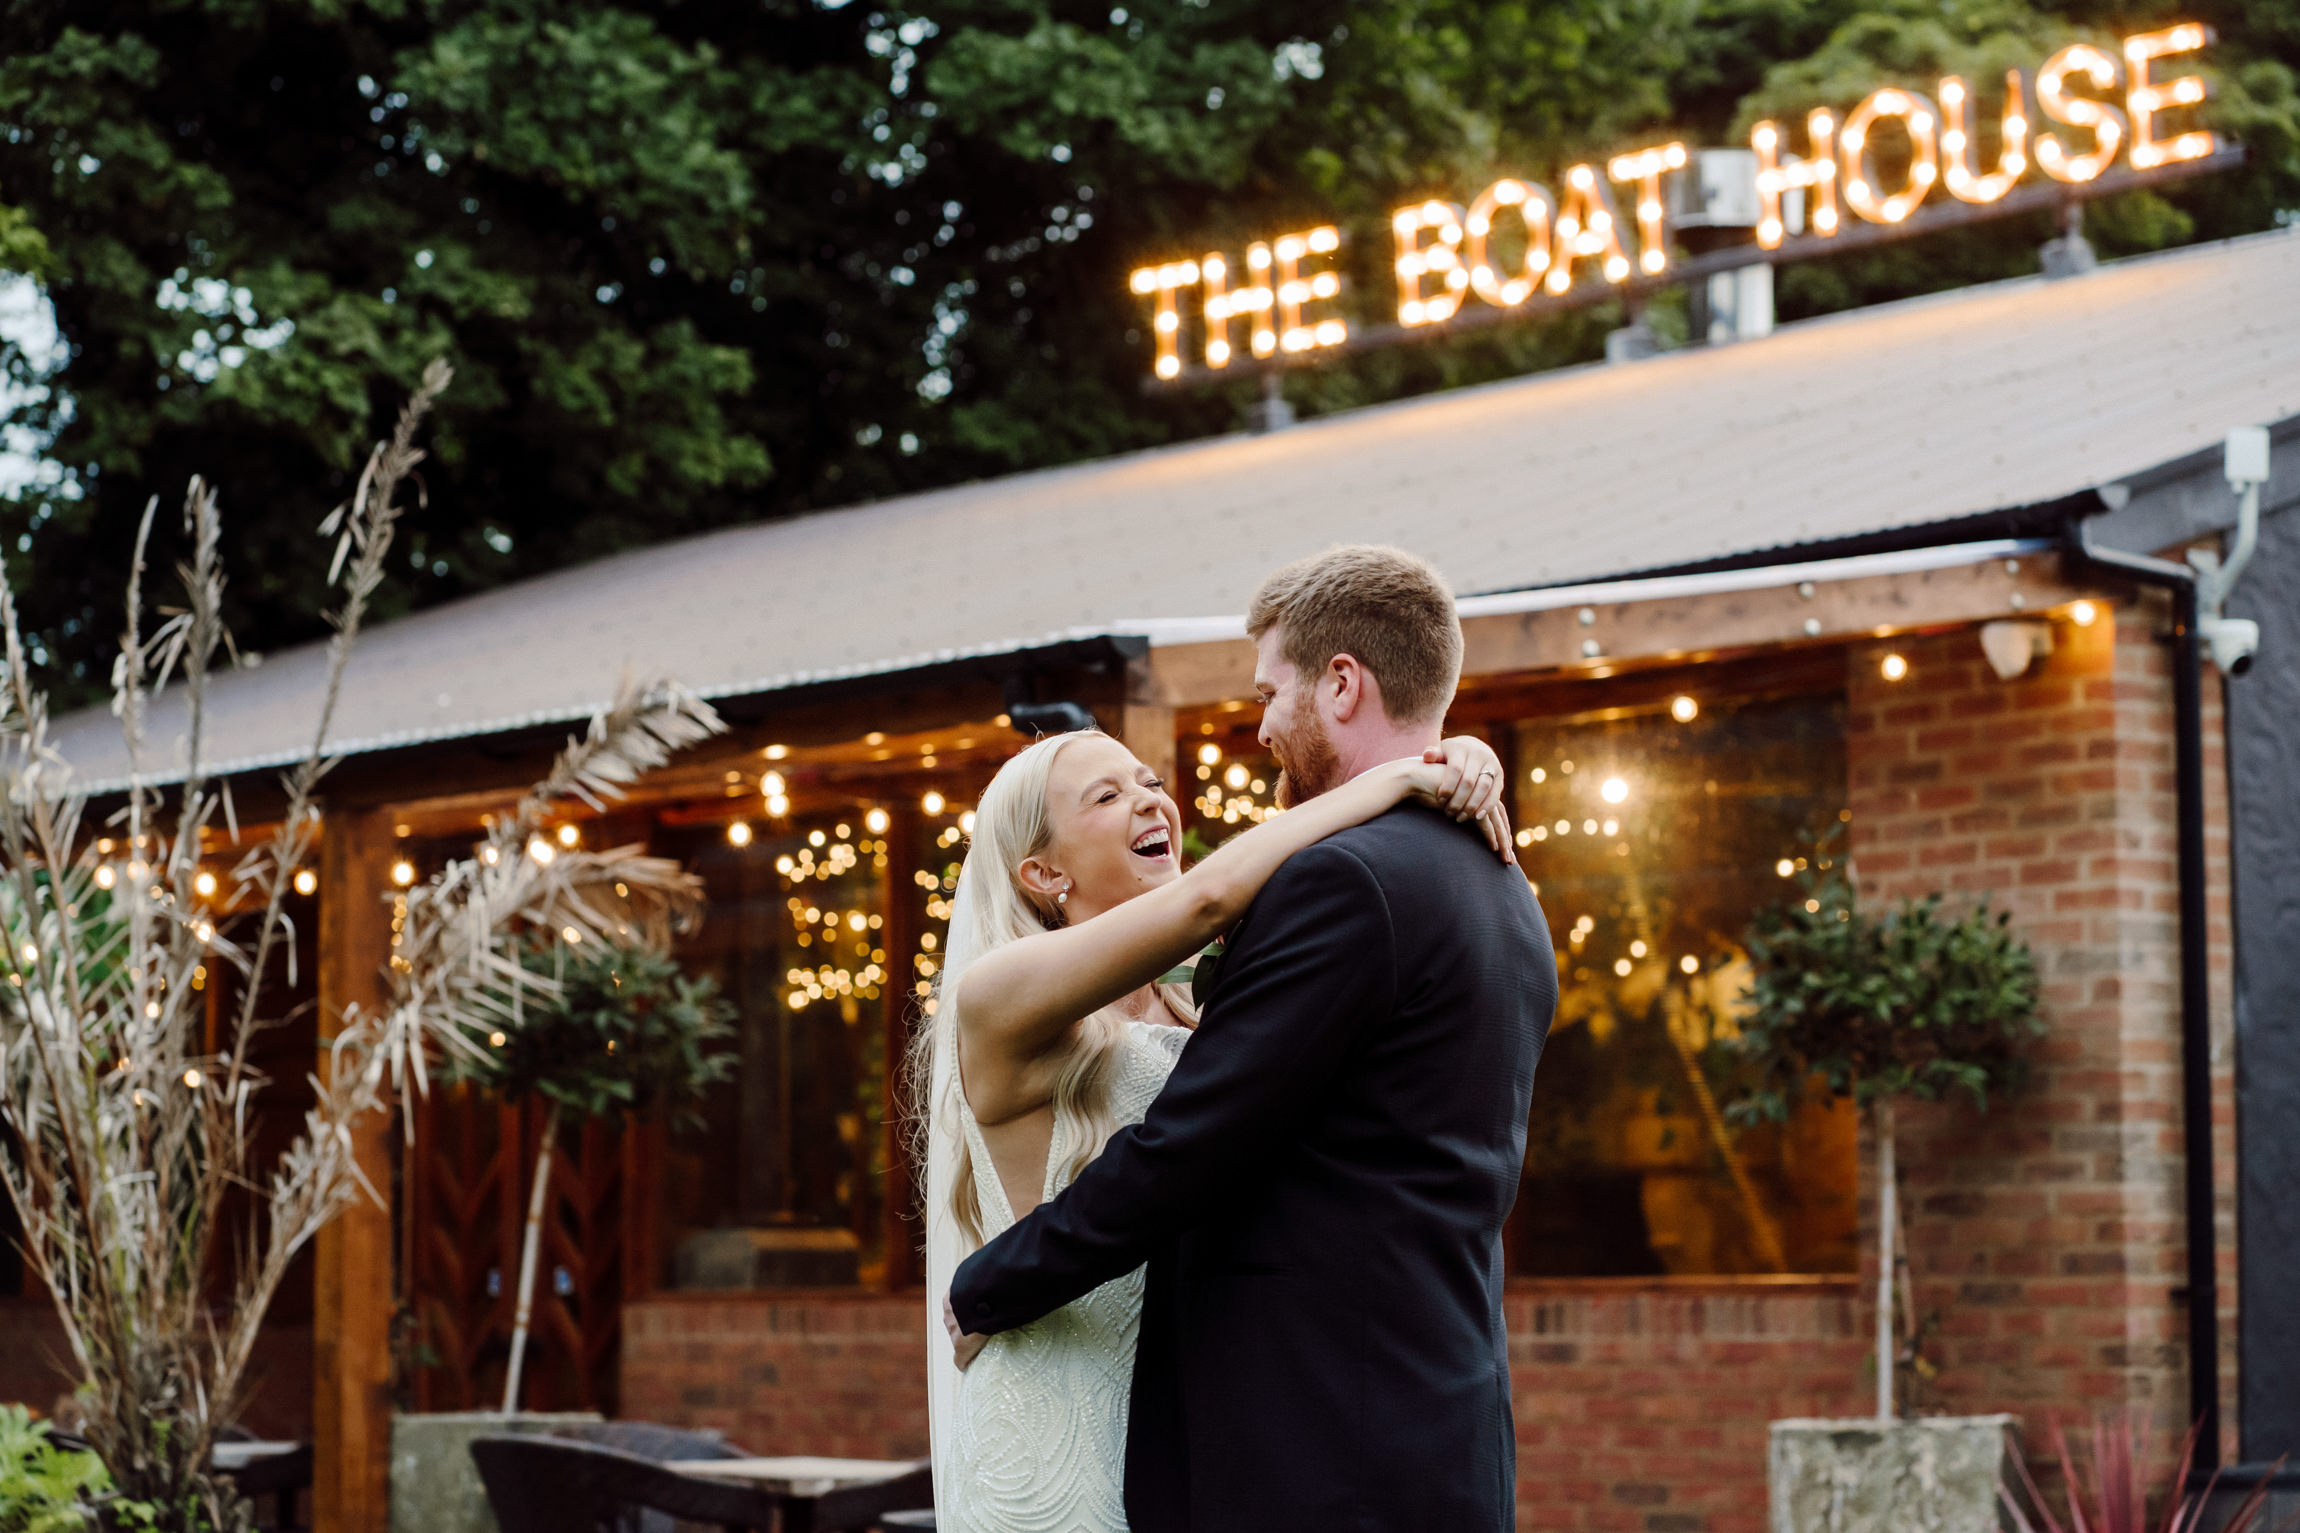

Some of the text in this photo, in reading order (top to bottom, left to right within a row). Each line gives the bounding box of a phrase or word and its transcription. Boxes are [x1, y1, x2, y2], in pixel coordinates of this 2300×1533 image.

[1130, 22, 2213, 380] THE BOAT HOUSE
